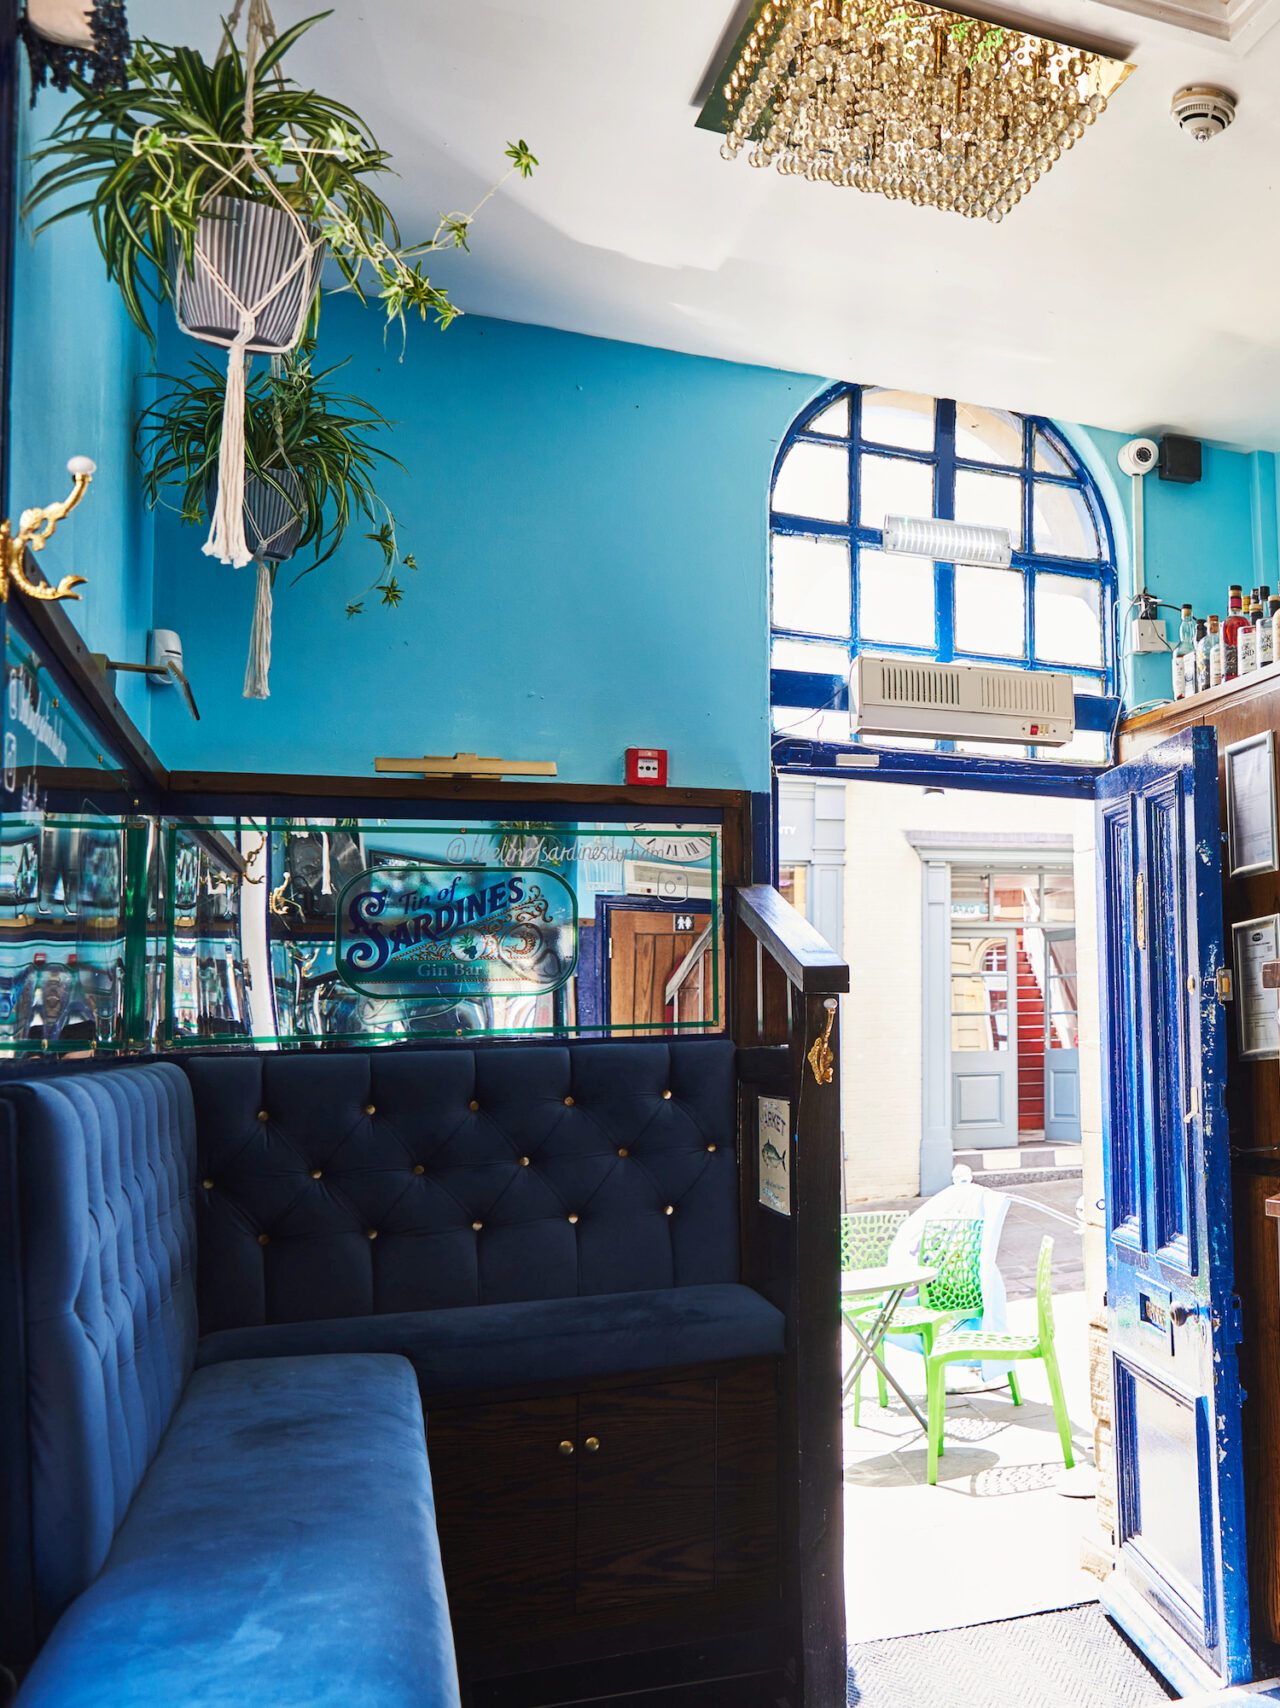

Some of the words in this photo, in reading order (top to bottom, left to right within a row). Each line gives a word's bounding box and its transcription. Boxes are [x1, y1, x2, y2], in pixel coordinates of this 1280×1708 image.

[402, 888, 432, 917] Tin
[437, 876, 462, 903] of
[346, 876, 526, 973] SARDINES
[417, 962, 448, 978] Gin
[454, 963, 483, 977] Bar
